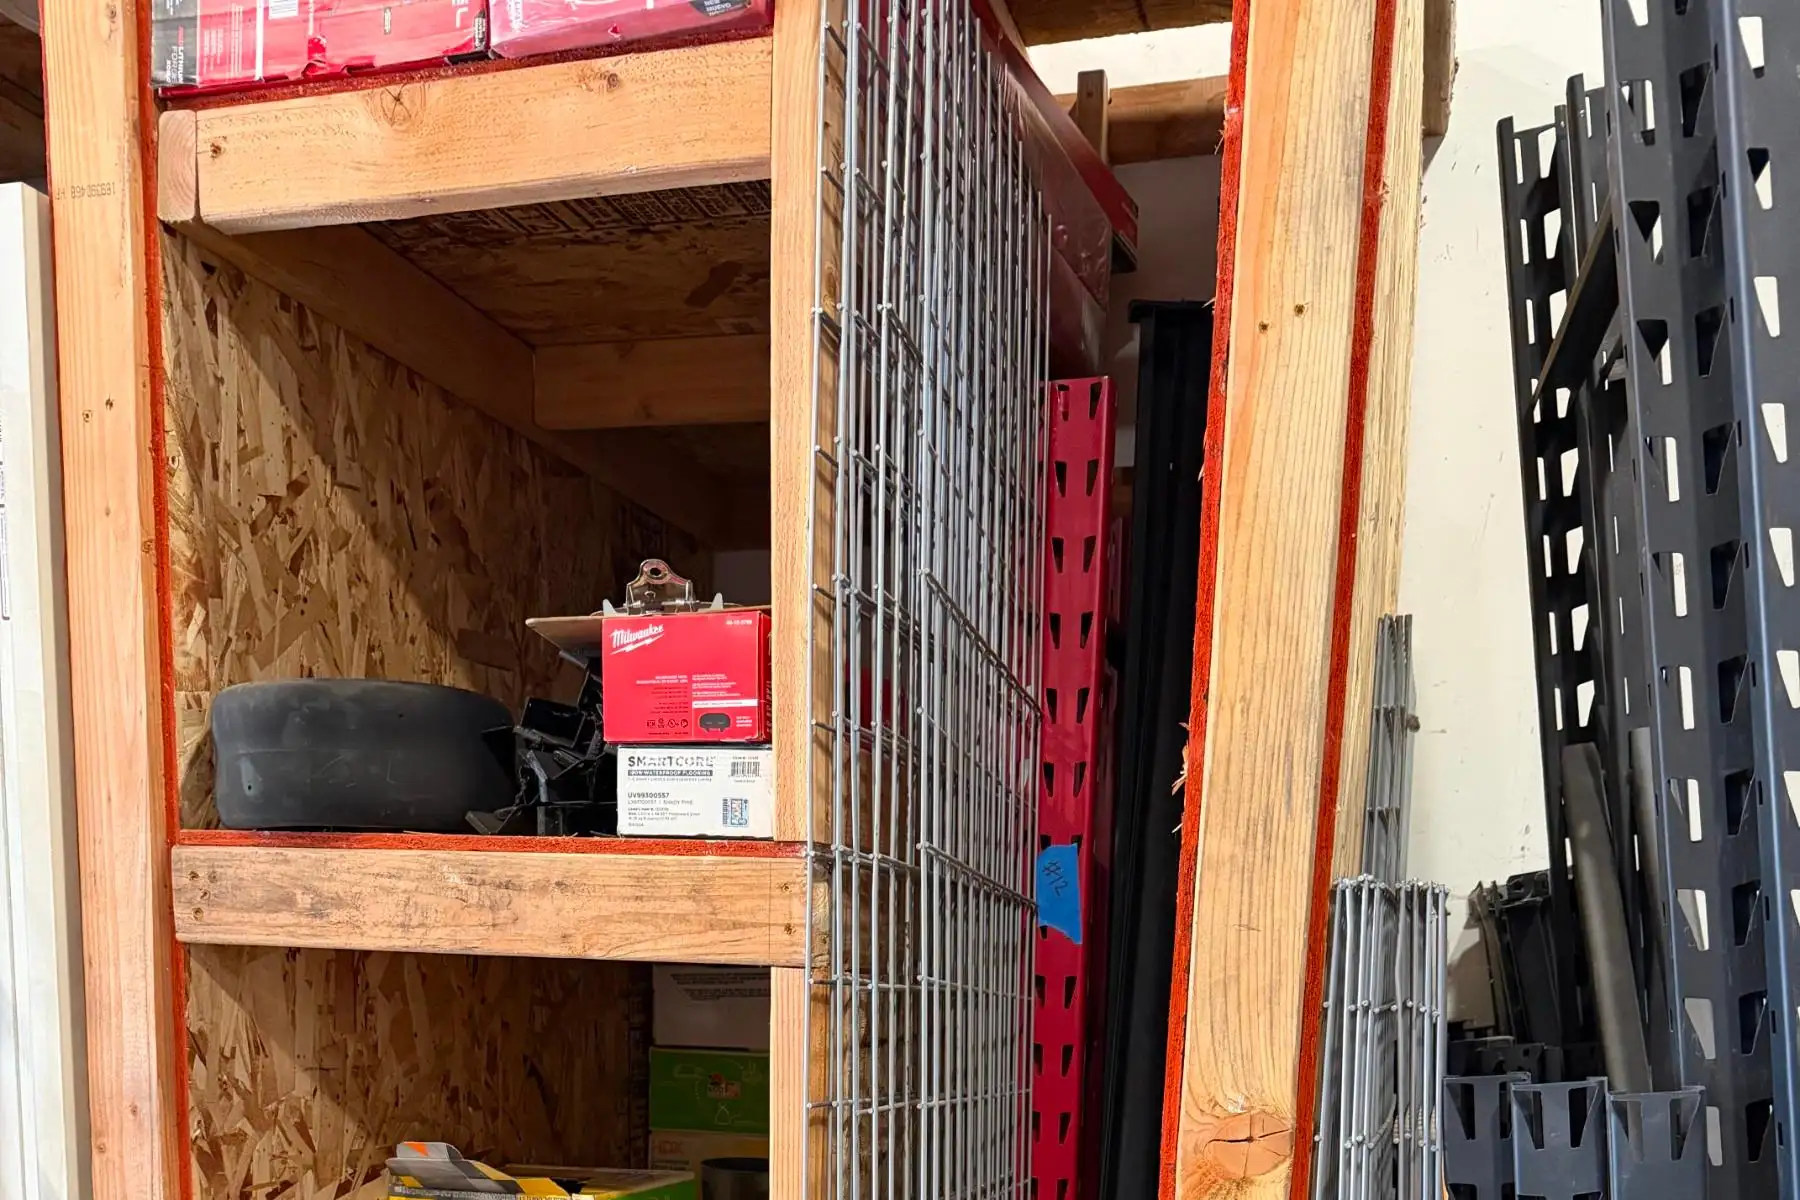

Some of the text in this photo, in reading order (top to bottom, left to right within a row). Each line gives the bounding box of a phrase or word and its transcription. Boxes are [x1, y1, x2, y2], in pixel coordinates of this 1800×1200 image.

[609, 623, 665, 648] Milwaukee
[628, 755, 714, 768] SMARTCORE
[1042, 859, 1069, 897] #12
